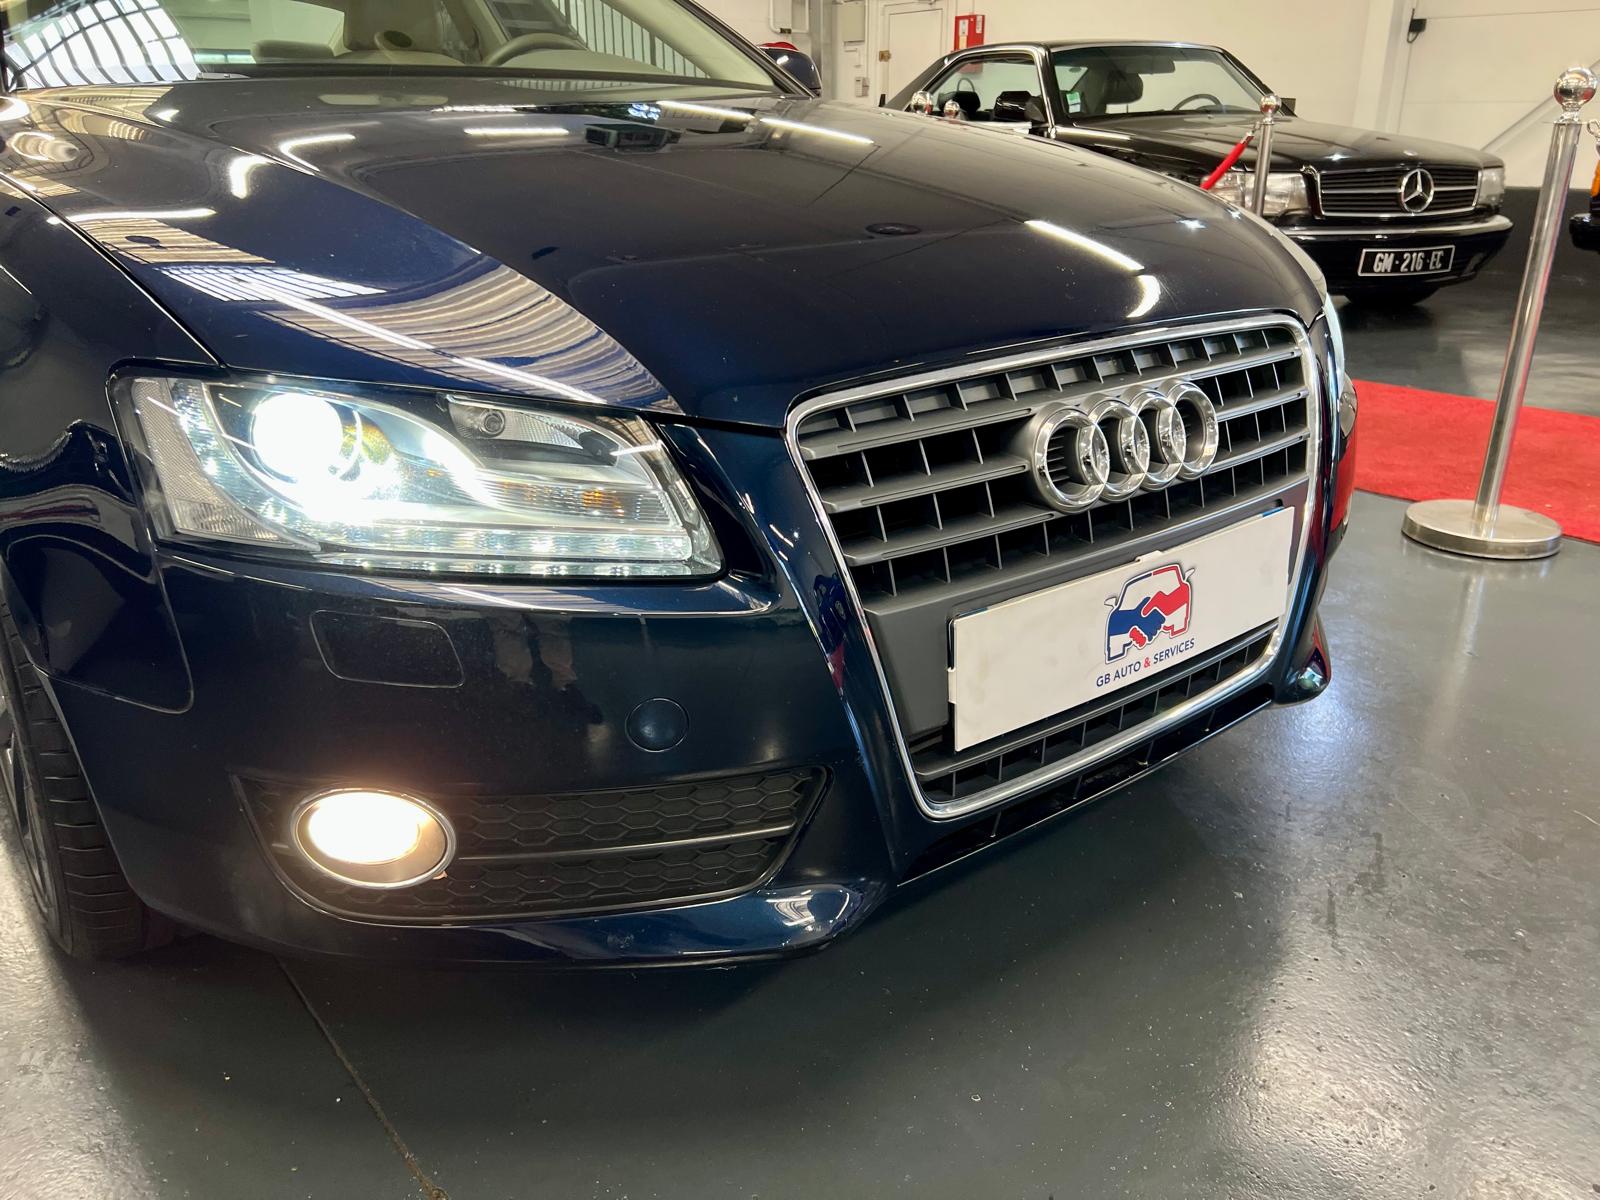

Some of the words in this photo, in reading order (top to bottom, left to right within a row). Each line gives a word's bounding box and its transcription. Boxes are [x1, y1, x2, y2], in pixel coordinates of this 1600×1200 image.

[1096, 673, 1111, 687] GB
[1113, 661, 1142, 681] AUTO
[1143, 657, 1151, 668] &
[1153, 638, 1195, 664] SERVICES
